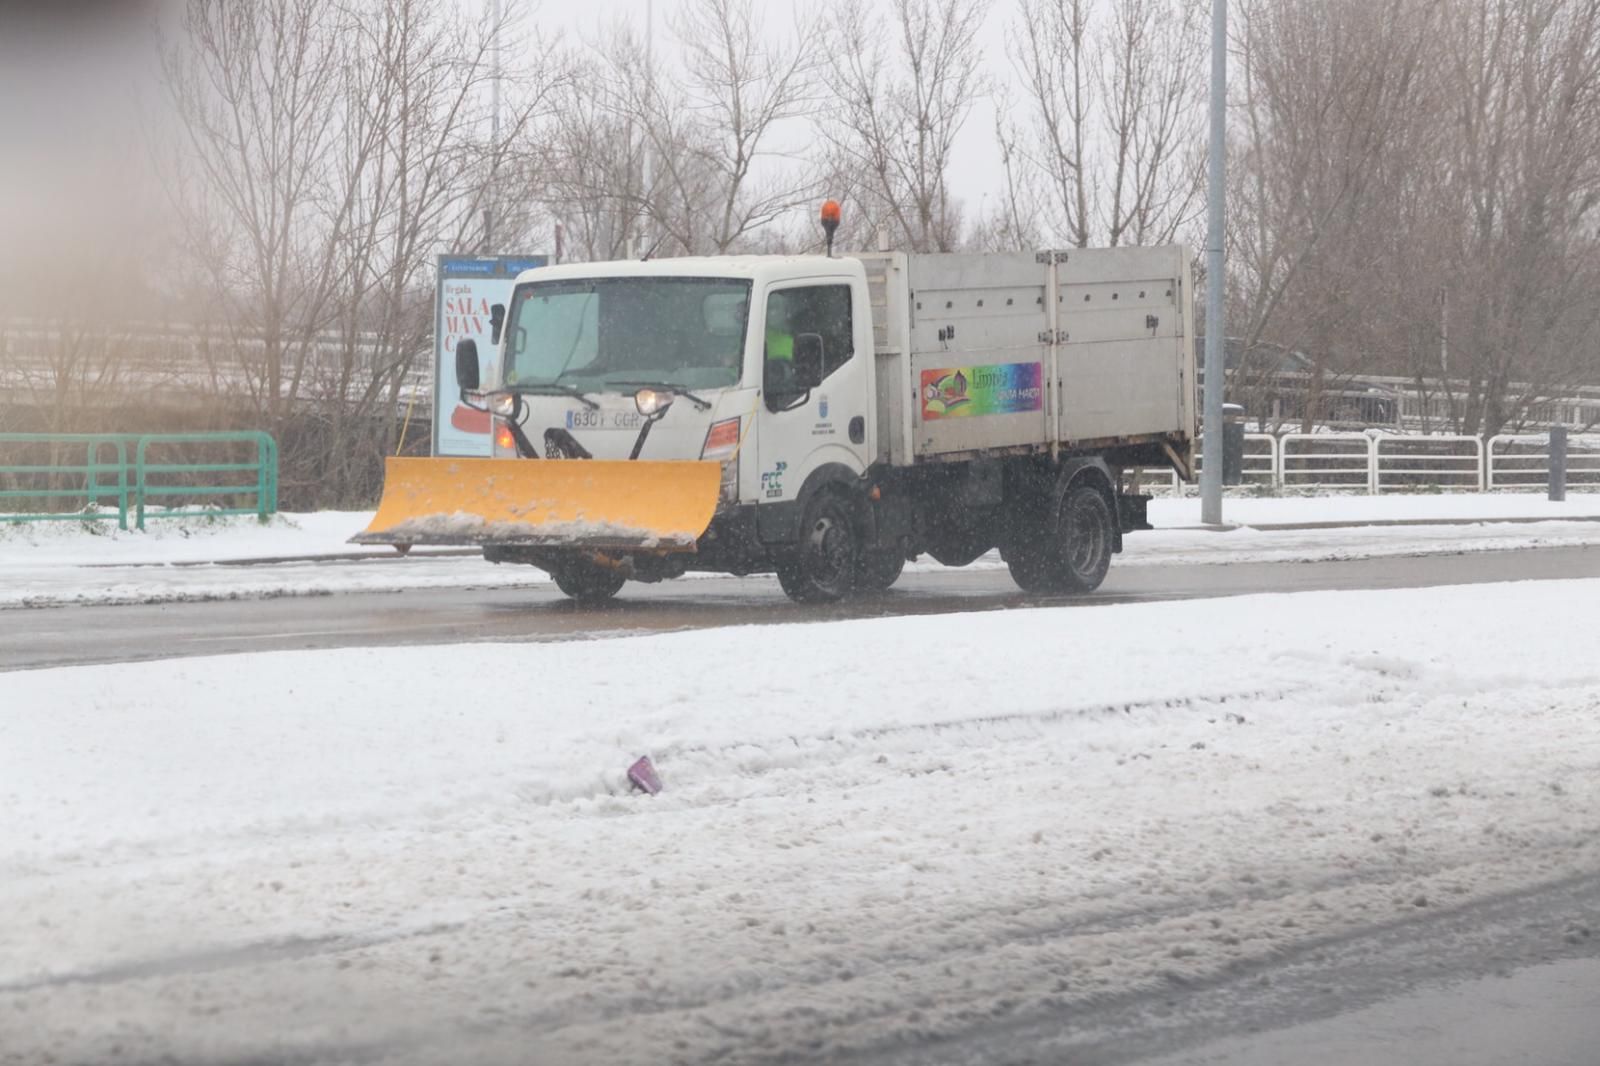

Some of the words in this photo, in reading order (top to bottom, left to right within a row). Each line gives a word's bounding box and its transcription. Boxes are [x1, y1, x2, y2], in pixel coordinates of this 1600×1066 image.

[446, 297, 490, 316] SALA
[446, 316, 485, 334] MAN
[761, 471, 783, 491] FCC
